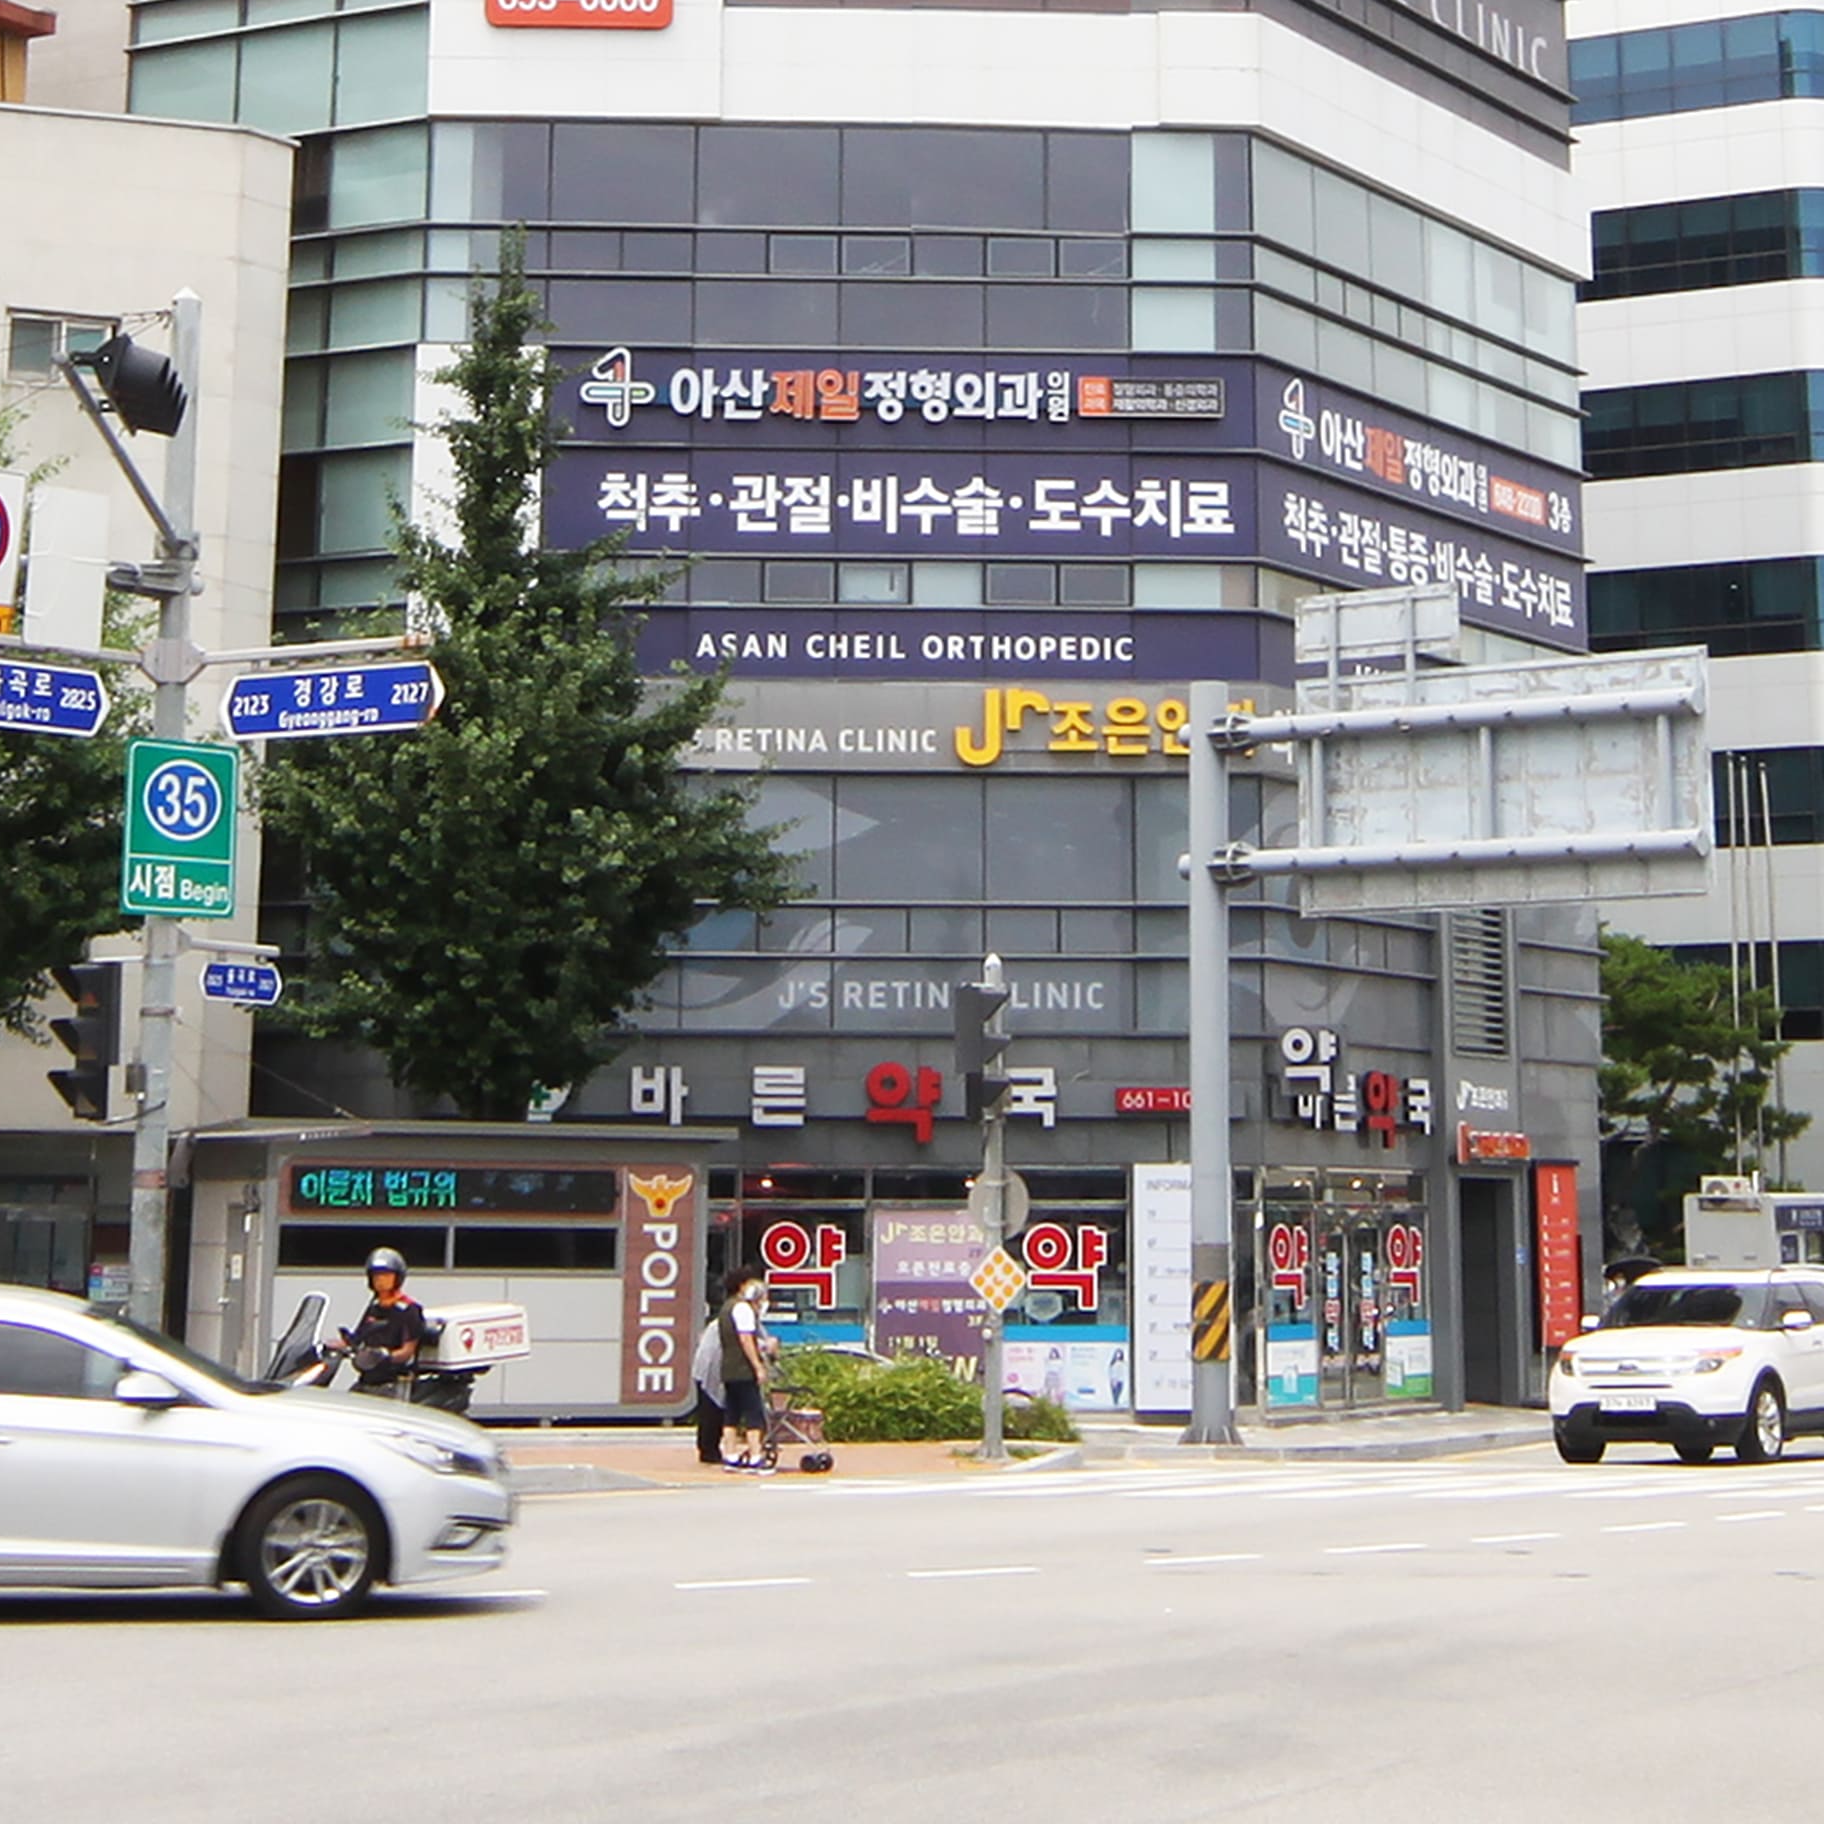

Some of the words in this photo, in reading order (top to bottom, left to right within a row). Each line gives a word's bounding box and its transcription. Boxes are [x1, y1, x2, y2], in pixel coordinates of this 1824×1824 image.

[671, 367, 1043, 422] 아산제일정형외과
[1548, 492, 1572, 533] 3층
[696, 633, 787, 660] ASAN
[806, 634, 906, 661] CHEIL
[922, 634, 1133, 662] ORTHOPEDIC
[233, 694, 270, 717] 2123
[294, 674, 364, 707] 경강로
[391, 682, 428, 705] 2127
[279, 708, 379, 729] Gyeonggang-ro
[714, 728, 828, 753] RETINA
[839, 728, 936, 753] CLINIC
[156, 773, 209, 824] 35
[129, 867, 175, 900] 시점
[180, 878, 229, 905] Begin
[779, 982, 829, 1010] J'S
[843, 982, 952, 1010] RETIN
[1010, 982, 1104, 1009] LINIC
[1281, 1027, 1337, 1093] 약
[632, 1063, 1057, 1144] 바른약국
[1298, 1071, 1431, 1149] 바른약국
[760, 1221, 846, 1310] 약
[1023, 1222, 1107, 1311] 약
[1270, 1224, 1308, 1310] 약
[1387, 1224, 1423, 1306] 약
[638, 1223, 677, 1395] POLICE
